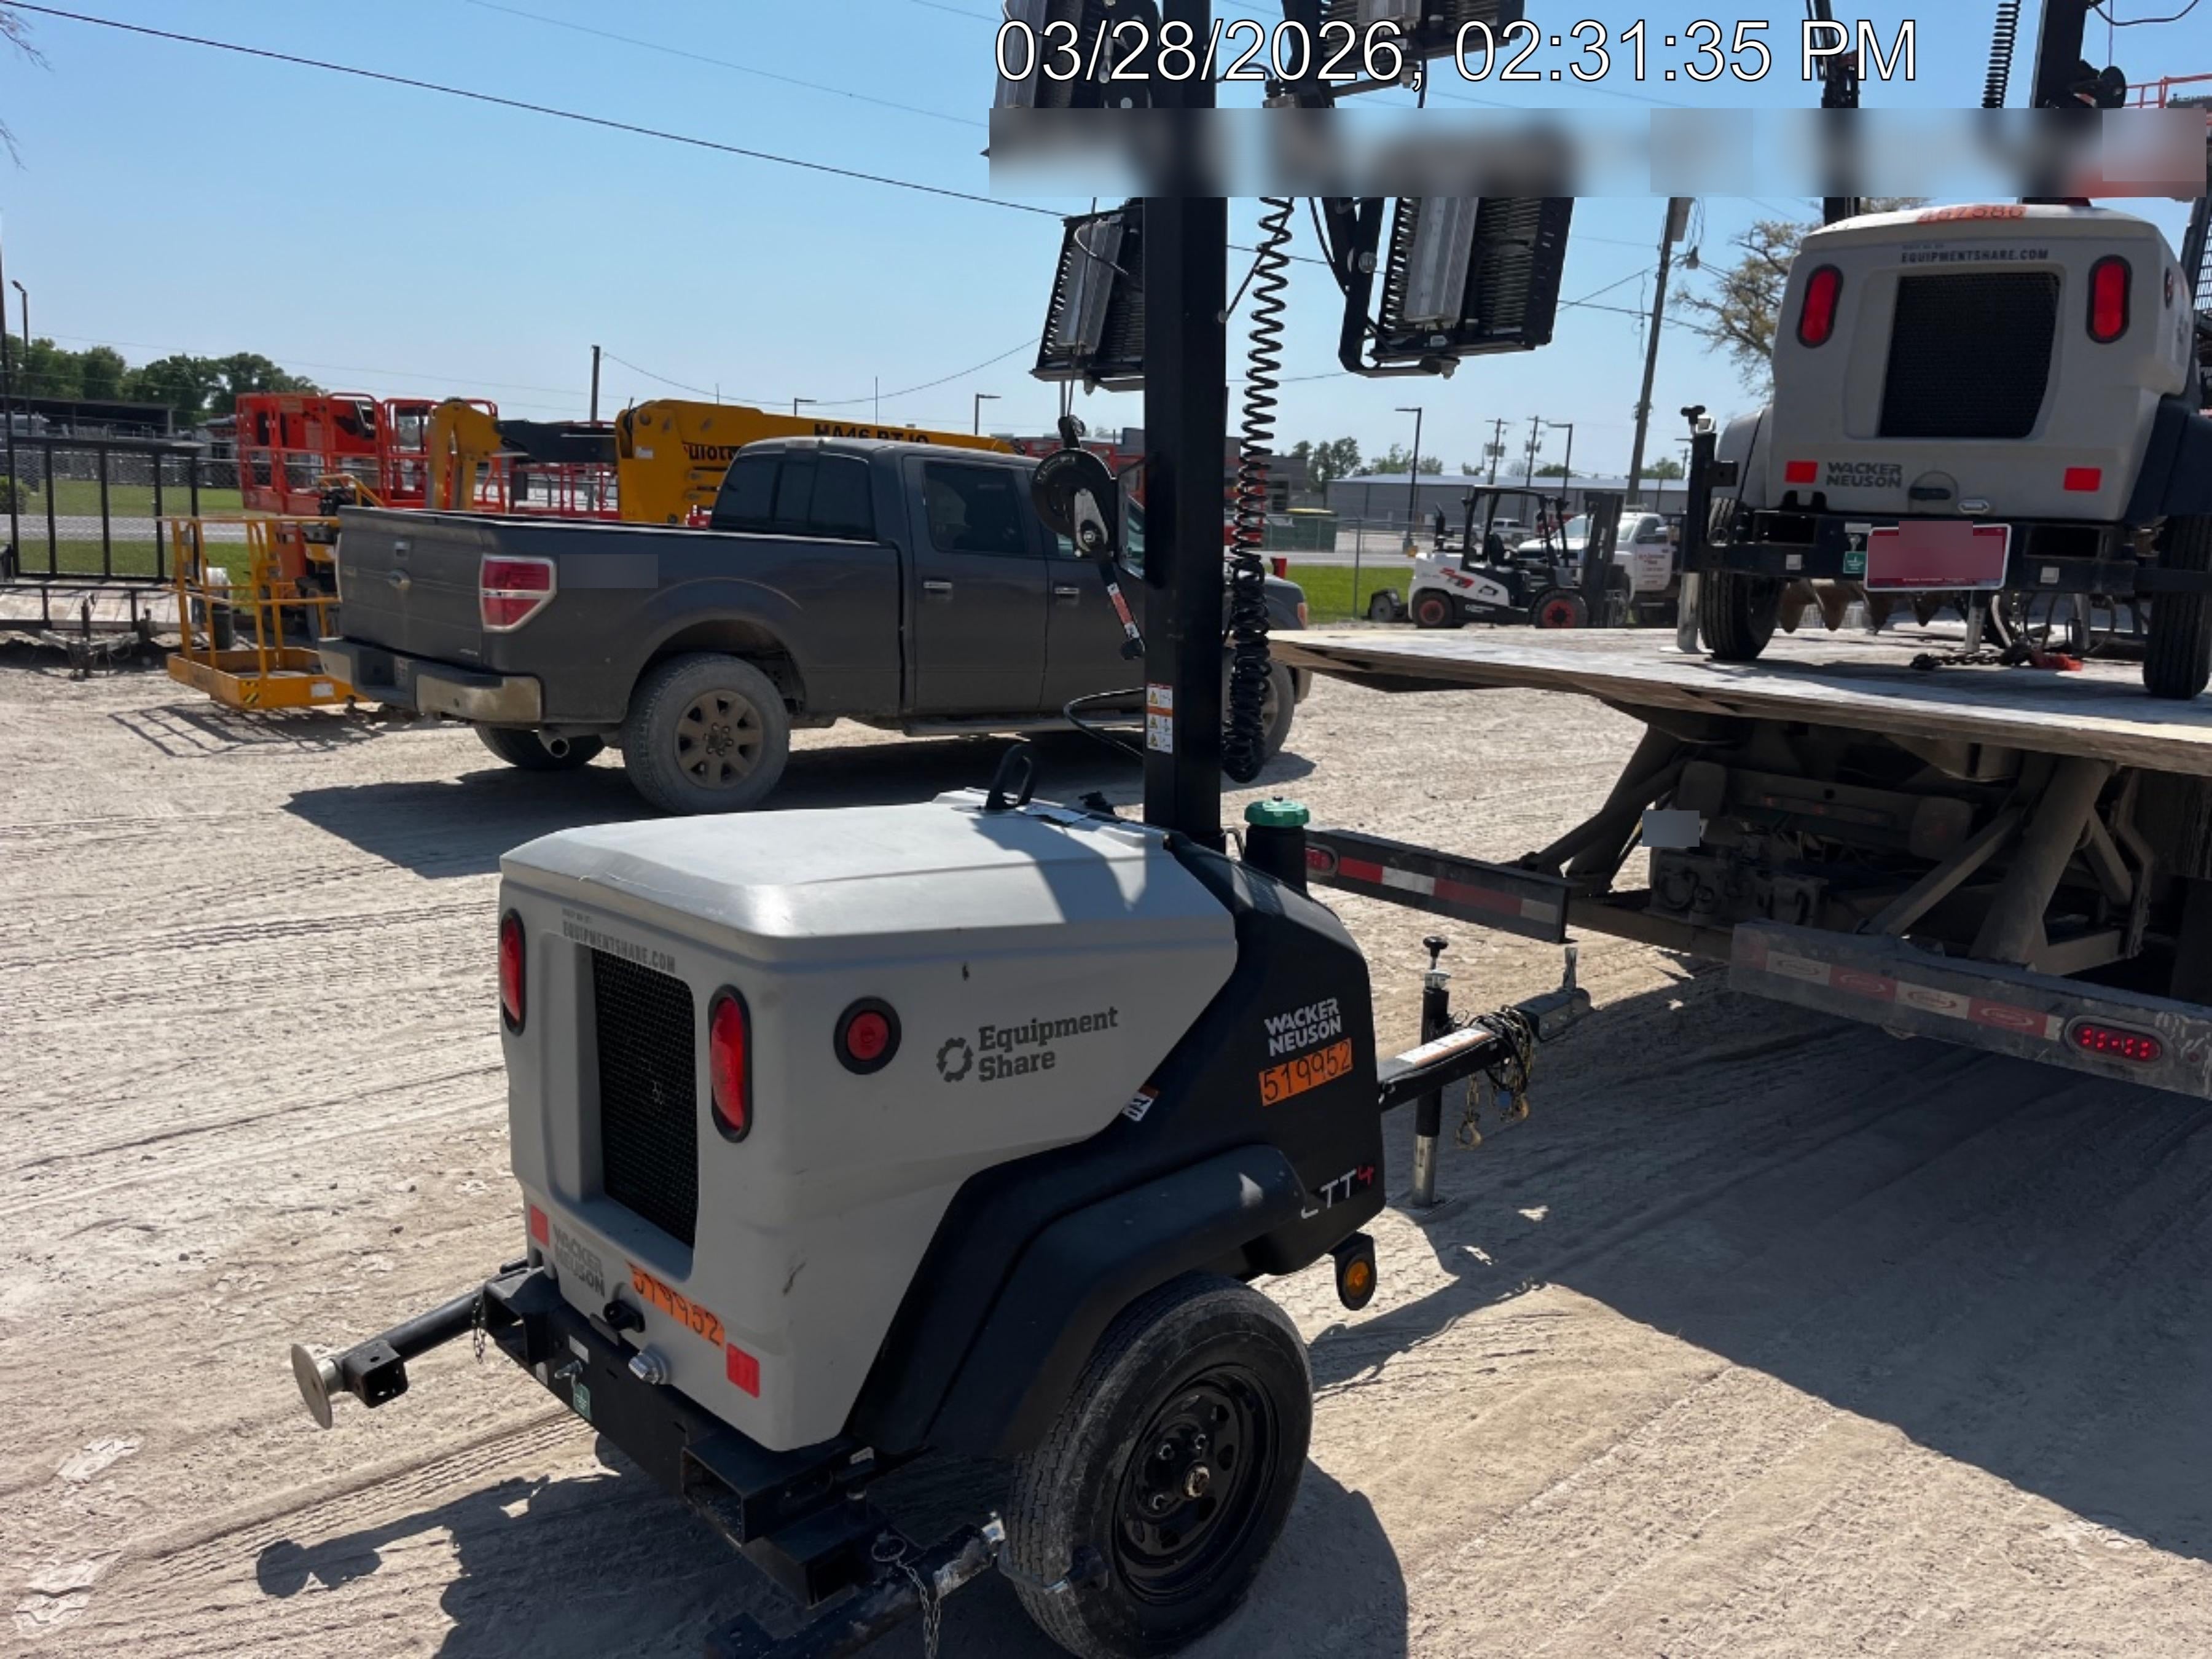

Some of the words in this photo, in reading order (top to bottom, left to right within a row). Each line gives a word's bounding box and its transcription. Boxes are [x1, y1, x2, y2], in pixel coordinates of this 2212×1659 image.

[1902, 249, 2049, 262] EQUIPMENTSHARE.COM
[1826, 475, 1902, 488] NEUSON
[1827, 461, 1903, 476] WACKER
[563, 919, 675, 974] EQUIPMENTSHARE.COM
[978, 1006, 1118, 1053] Equipment
[1264, 997, 1339, 1036] WACKER
[1269, 1015, 1342, 1057] NEUSON
[978, 1050, 1056, 1082] Share
[1263, 1041, 1351, 1100] 519952
